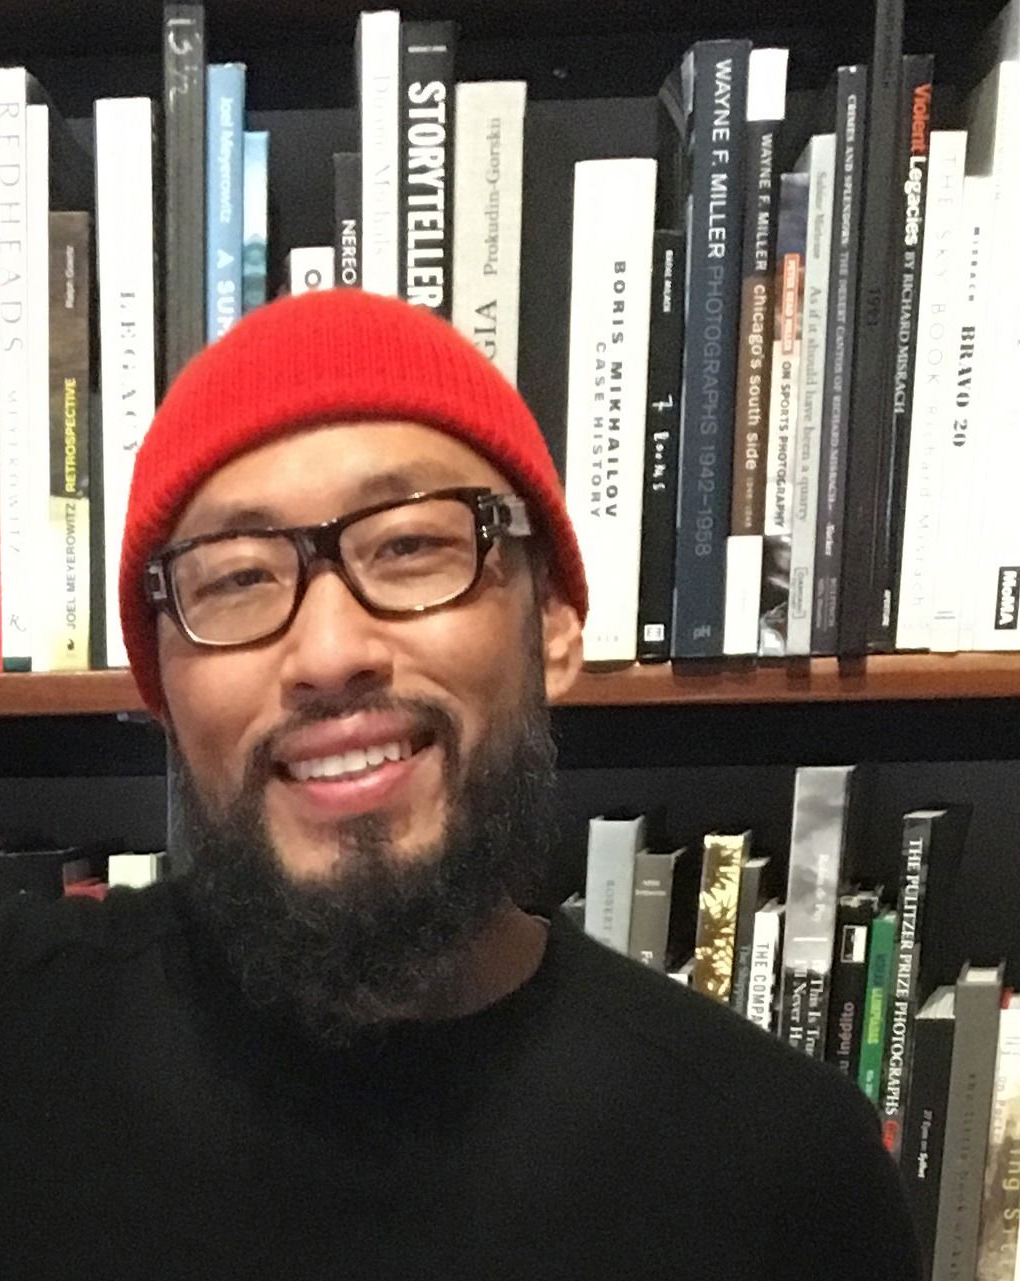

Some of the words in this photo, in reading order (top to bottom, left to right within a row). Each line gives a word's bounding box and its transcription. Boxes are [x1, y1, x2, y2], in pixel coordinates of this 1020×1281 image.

[167, 17, 202, 55] 13
[220, 97, 234, 128] Joel
[712, 59, 733, 141] WAYNE
[845, 94, 857, 142] CRIMES
[910, 83, 933, 155] Violent
[217, 130, 235, 223] Meyerowitz
[711, 150, 729, 166] F.
[759, 133, 772, 188] WAYNE
[843, 146, 855, 171] AND
[407, 81, 446, 308] STORYTELLER
[707, 173, 729, 258] MILLER
[758, 195, 770, 208] F.
[903, 156, 927, 246] Legacies
[217, 249, 234, 268] A
[342, 220, 356, 284] NEREO
[755, 211, 770, 271] MILLER
[839, 252, 849, 277] THE
[904, 251, 916, 271] BY
[611, 261, 626, 344] BORIS
[809, 286, 821, 304] As
[809, 310, 821, 321] if
[837, 279, 849, 323] DESERT
[899, 273, 915, 342] RICHARD
[700, 265, 726, 434] PHOTOGRAPHS
[747, 284, 769, 369] chicago's
[808, 324, 820, 333] it
[833, 326, 846, 373] CANTOS
[926, 303, 947, 384] BOOK
[593, 341, 607, 401] CASE
[781, 361, 792, 379] ON
[805, 337, 820, 385] should
[832, 376, 843, 391] OF
[895, 346, 910, 414] MISRACH
[956, 327, 976, 408] BRAVO
[652, 394, 674, 411] 7
[747, 375, 762, 427] south
[779, 383, 791, 431] SPORTS
[803, 390, 818, 422] have
[65, 378, 77, 492] RETROSPECTIVE
[605, 361, 623, 518] MIKHAILOV
[744, 433, 762, 470] side
[801, 426, 816, 461] been
[951, 418, 969, 448] 20
[590, 417, 605, 518] HISTORY
[774, 436, 789, 528] PHOTOGRAPHY
[800, 464, 810, 472] a
[795, 477, 810, 523] quarry
[65, 503, 78, 592] MEYEROWITZ
[65, 603, 77, 631] JOEL
[998, 571, 1018, 625] MoMA
[906, 838, 924, 875] THE
[900, 876, 919, 949] PULITZER
[754, 943, 770, 968] THE
[895, 955, 913, 997] PRIZE
[789, 983, 807, 1022] Never
[809, 976, 825, 1007] This
[807, 1011, 821, 1023] Is
[884, 1001, 908, 1116] PHOTOGRAPHS
